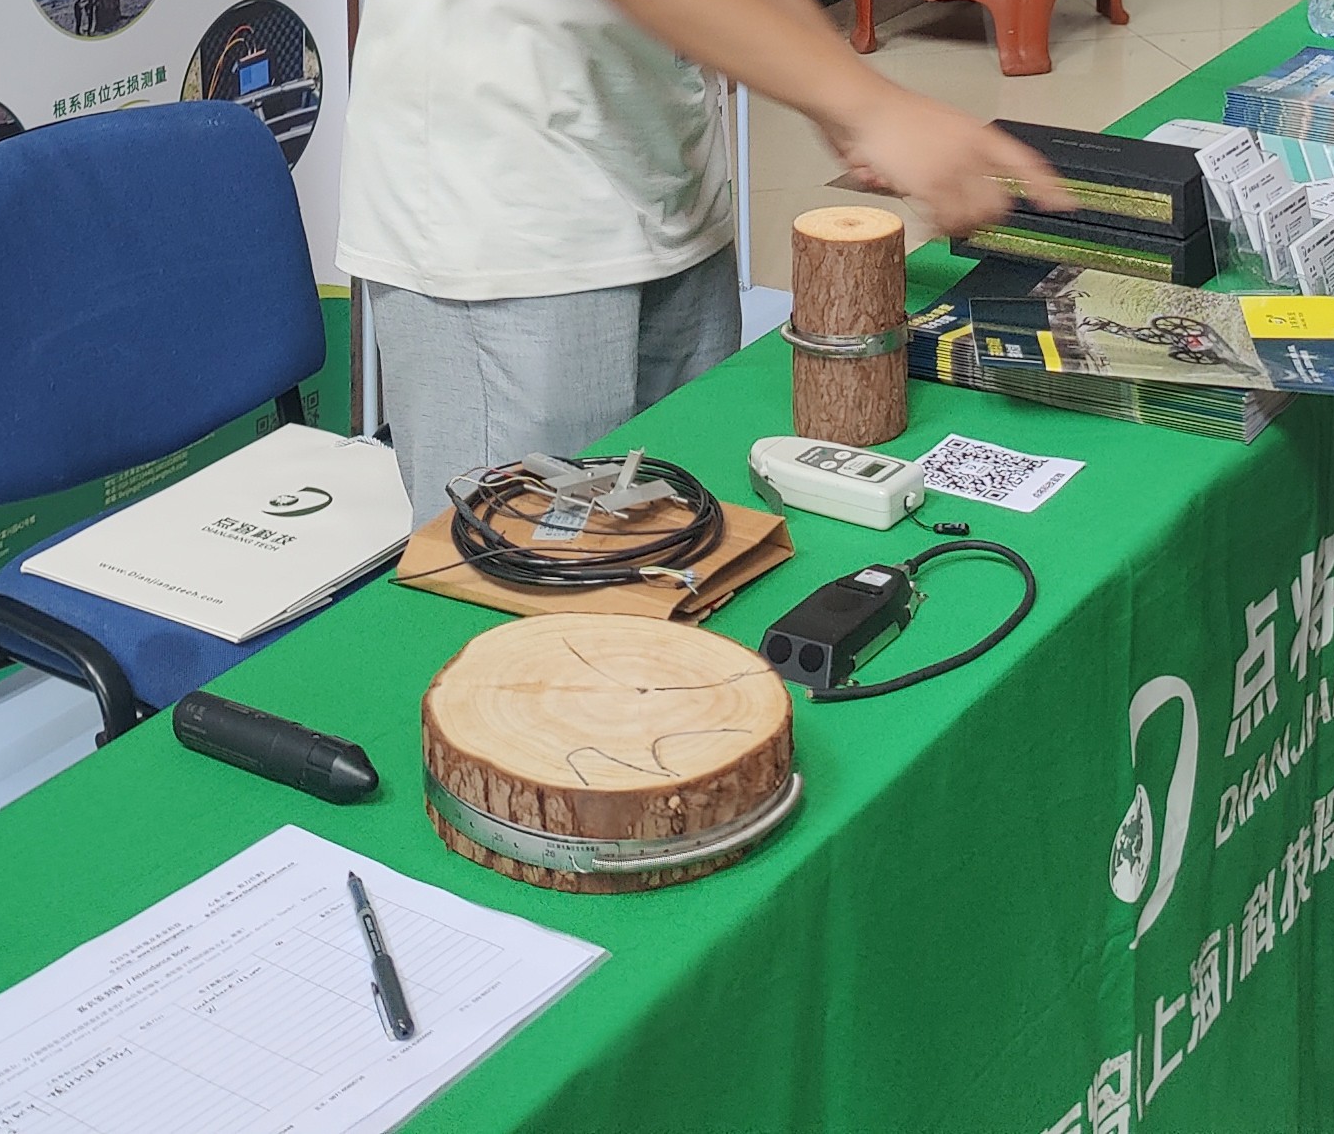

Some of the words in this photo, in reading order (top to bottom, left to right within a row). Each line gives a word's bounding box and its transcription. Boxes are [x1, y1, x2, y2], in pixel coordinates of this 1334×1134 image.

[53, 65, 168, 119] 根系原位无损测量
[201, 525, 254, 545] DIANJIANG
[253, 540, 280, 553] TECH
[212, 516, 298, 547] 点将科技
[98, 560, 224, 606] www.Dianjiangtech.com
